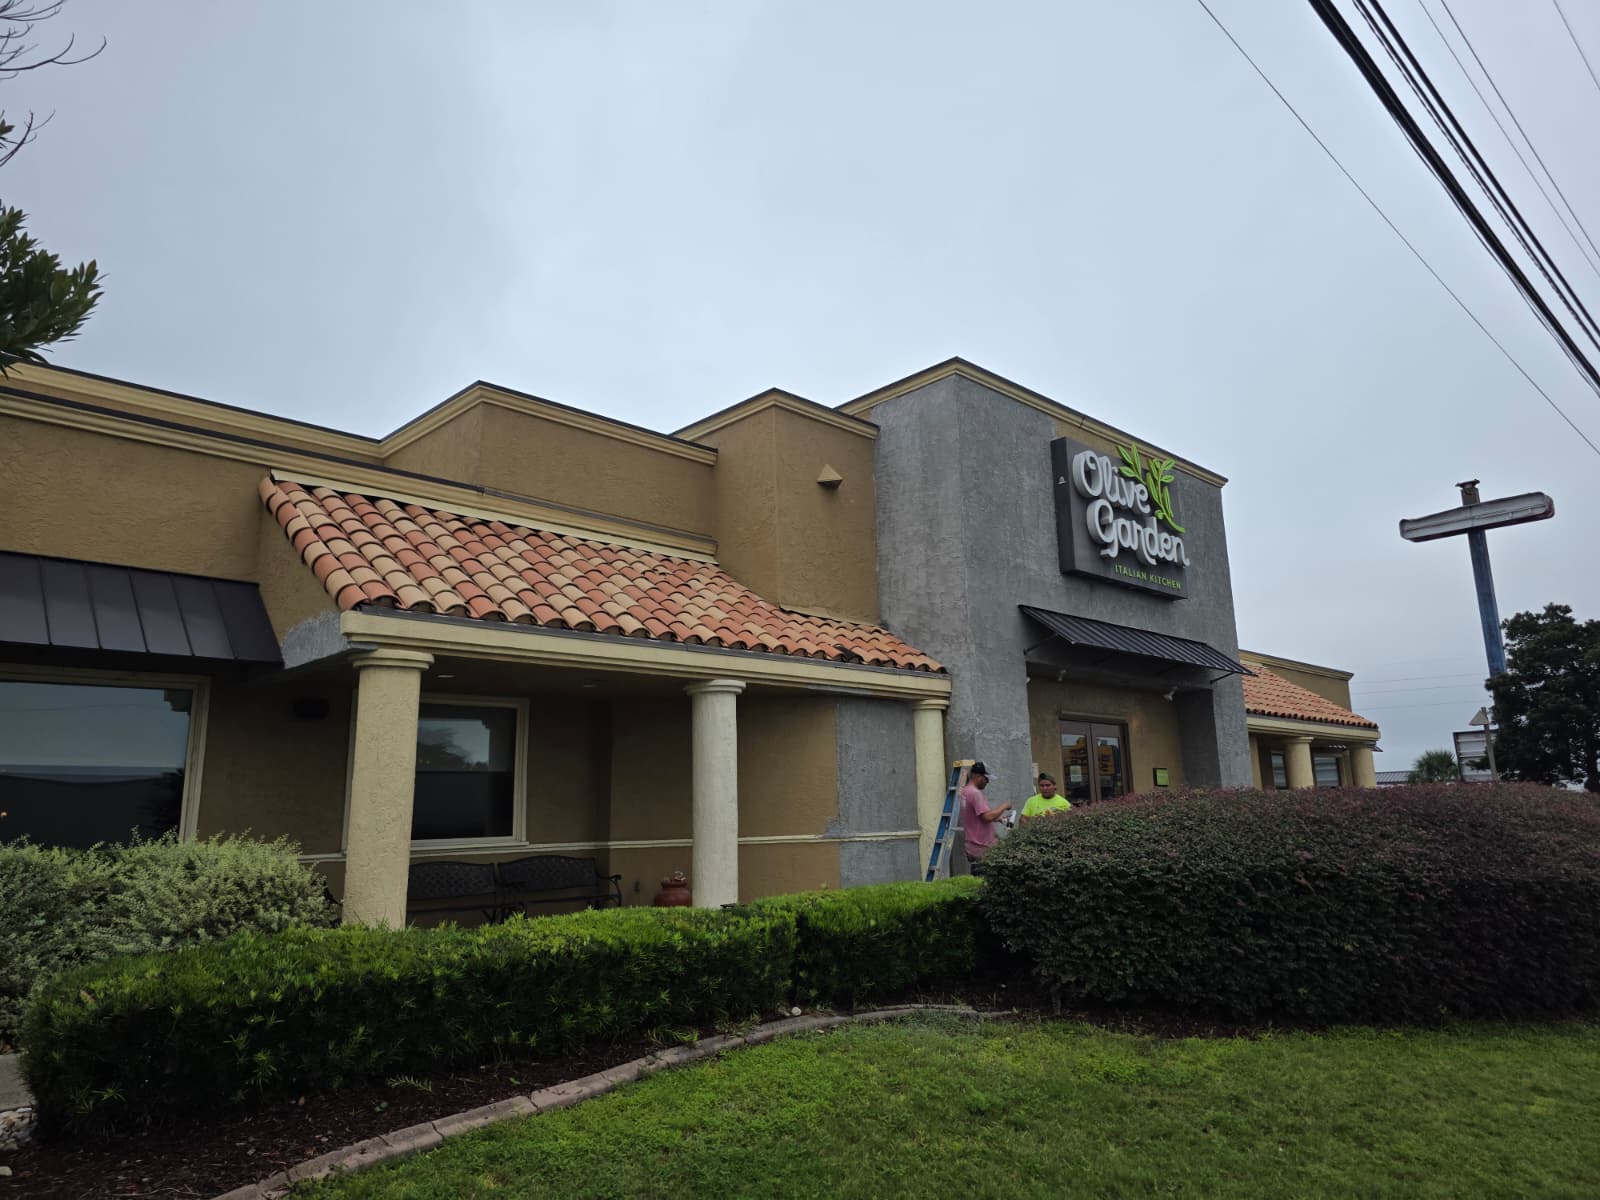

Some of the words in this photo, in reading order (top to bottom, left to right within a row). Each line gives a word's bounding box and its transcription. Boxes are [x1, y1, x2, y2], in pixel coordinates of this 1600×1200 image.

[1073, 450, 1150, 513] Olive
[1087, 499, 1190, 568] Garden
[1115, 565, 1147, 580] ITALIAN
[1149, 575, 1181, 589] KITCHEN
